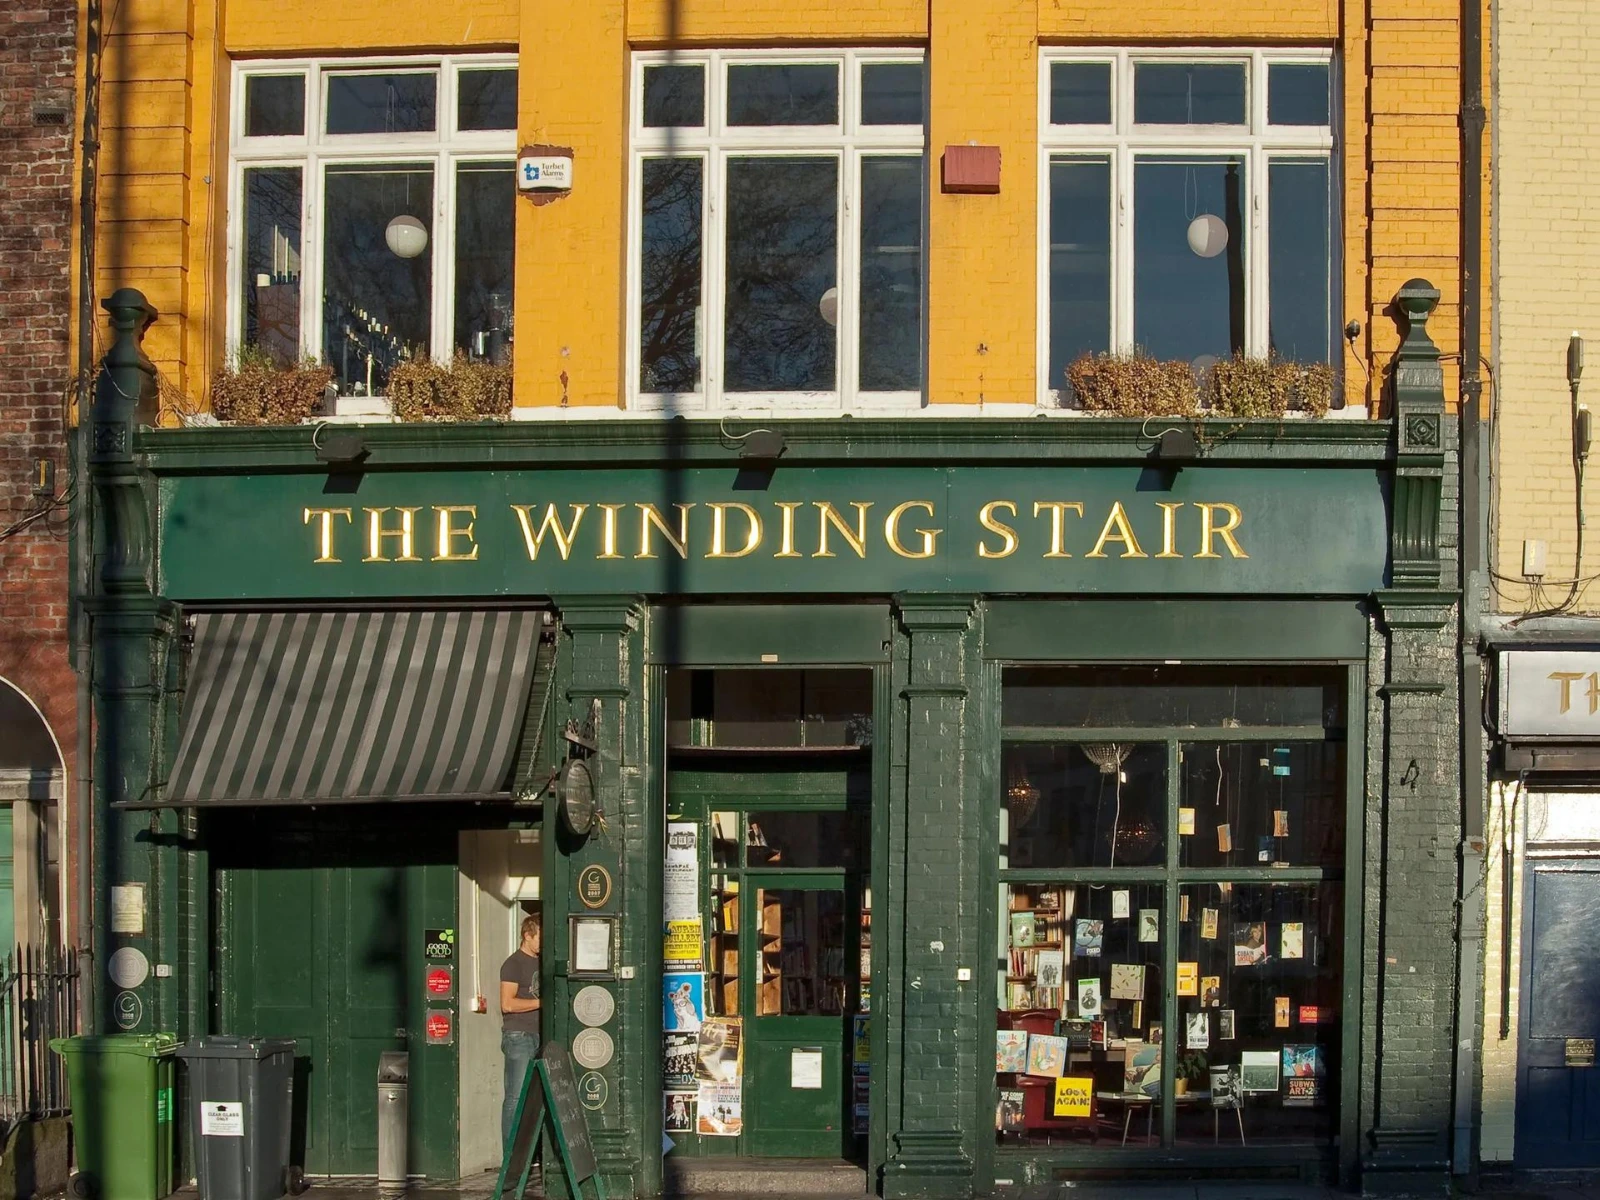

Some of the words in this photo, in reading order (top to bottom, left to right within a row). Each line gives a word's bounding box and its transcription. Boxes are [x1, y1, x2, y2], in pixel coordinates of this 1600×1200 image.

[303, 504, 479, 564] THE
[510, 501, 944, 562] WINDING
[978, 500, 1250, 560] STAIR
[426, 947, 452, 956] FOOD
[1060, 1087, 1087, 1096] LOOK
[1056, 1097, 1090, 1106] AGAIN!
